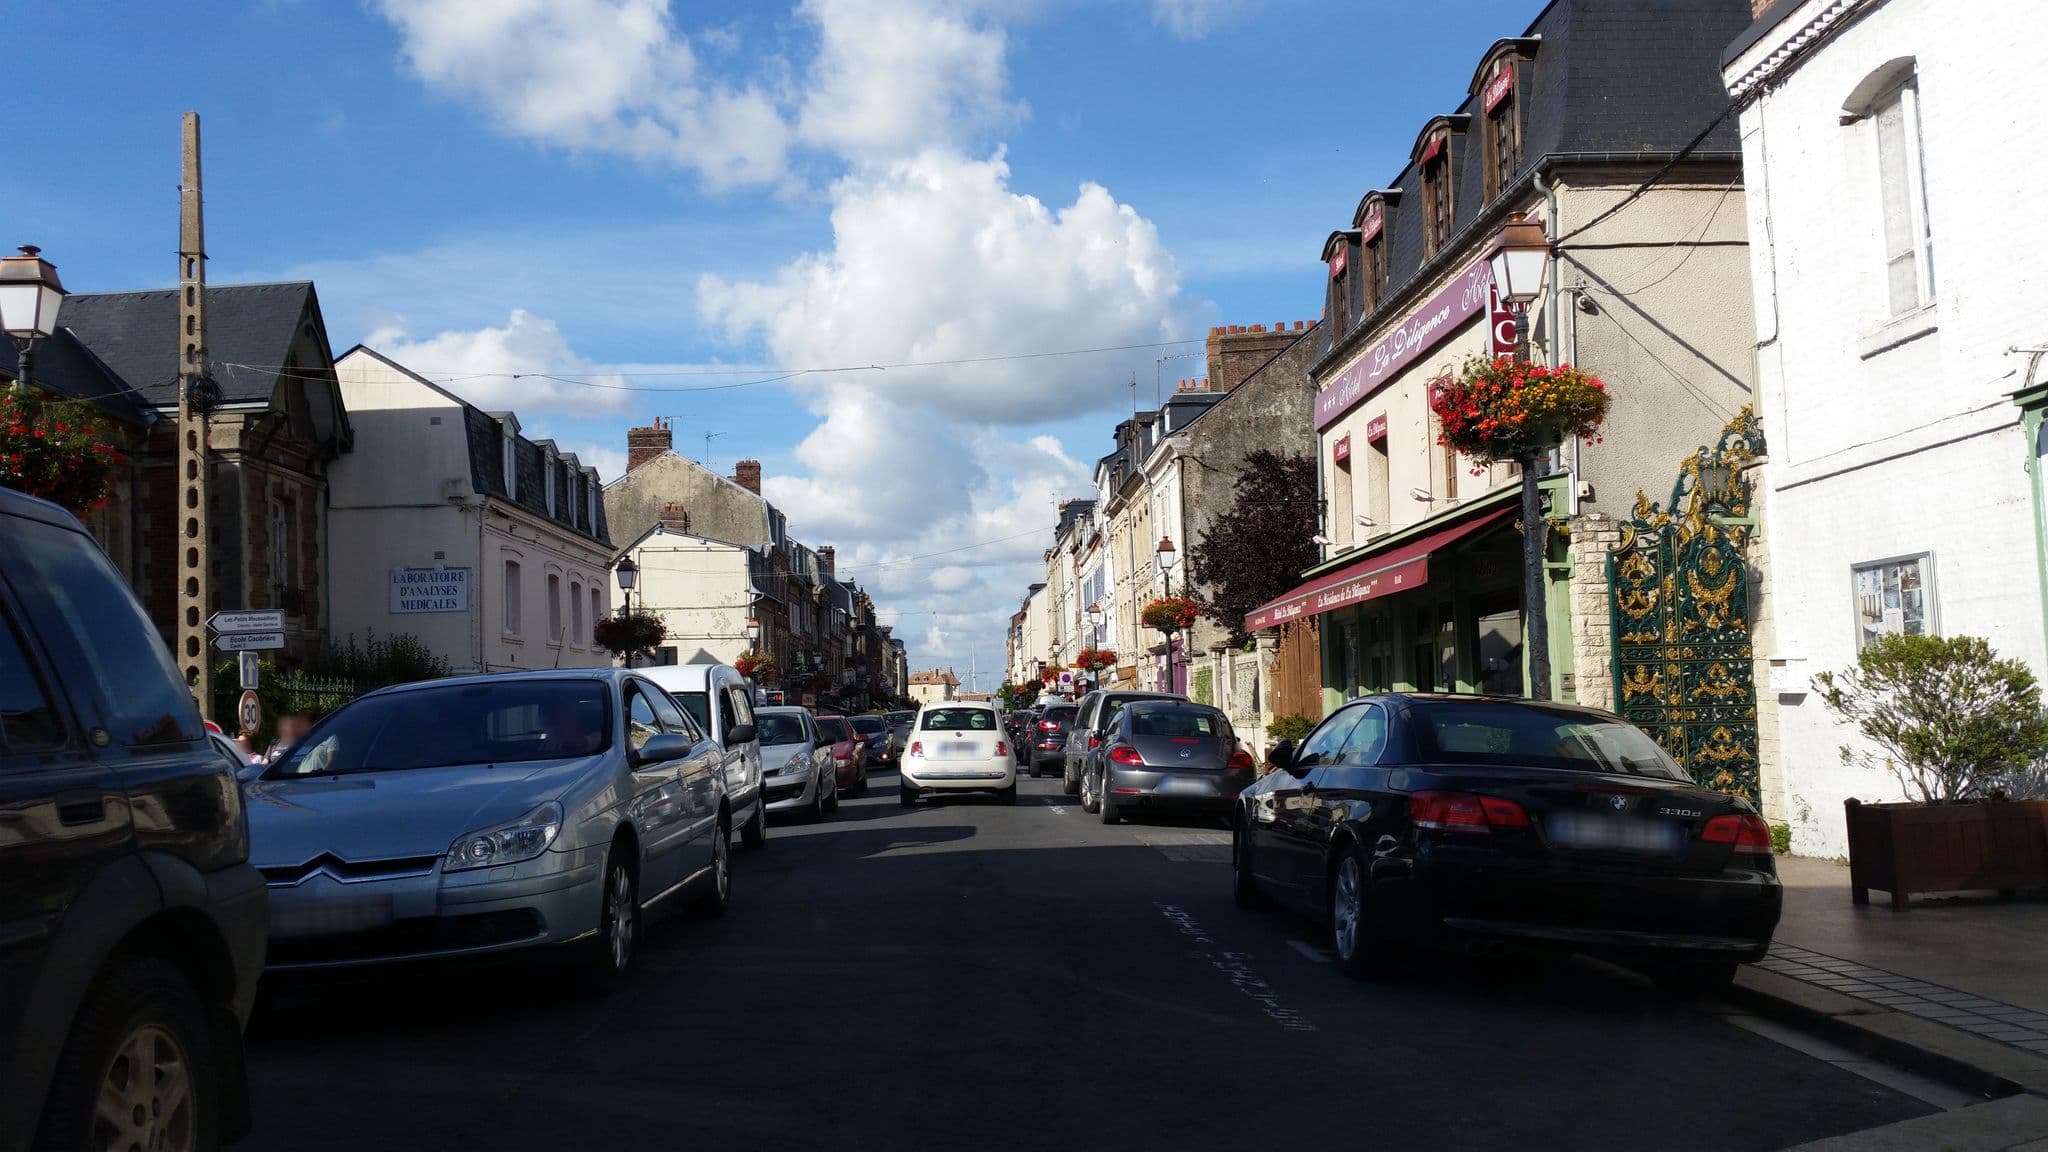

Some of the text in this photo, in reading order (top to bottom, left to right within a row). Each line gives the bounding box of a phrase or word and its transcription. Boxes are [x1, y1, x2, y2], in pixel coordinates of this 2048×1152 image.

[1340, 305, 1451, 405] Hôtel La Diligence
[393, 571, 465, 583] LABORATOIRE
[400, 585, 458, 596] D'ANALYSES
[400, 598, 457, 610] MEDICALES
[245, 703, 256, 724] 30
[1659, 807, 1701, 817] 330d
